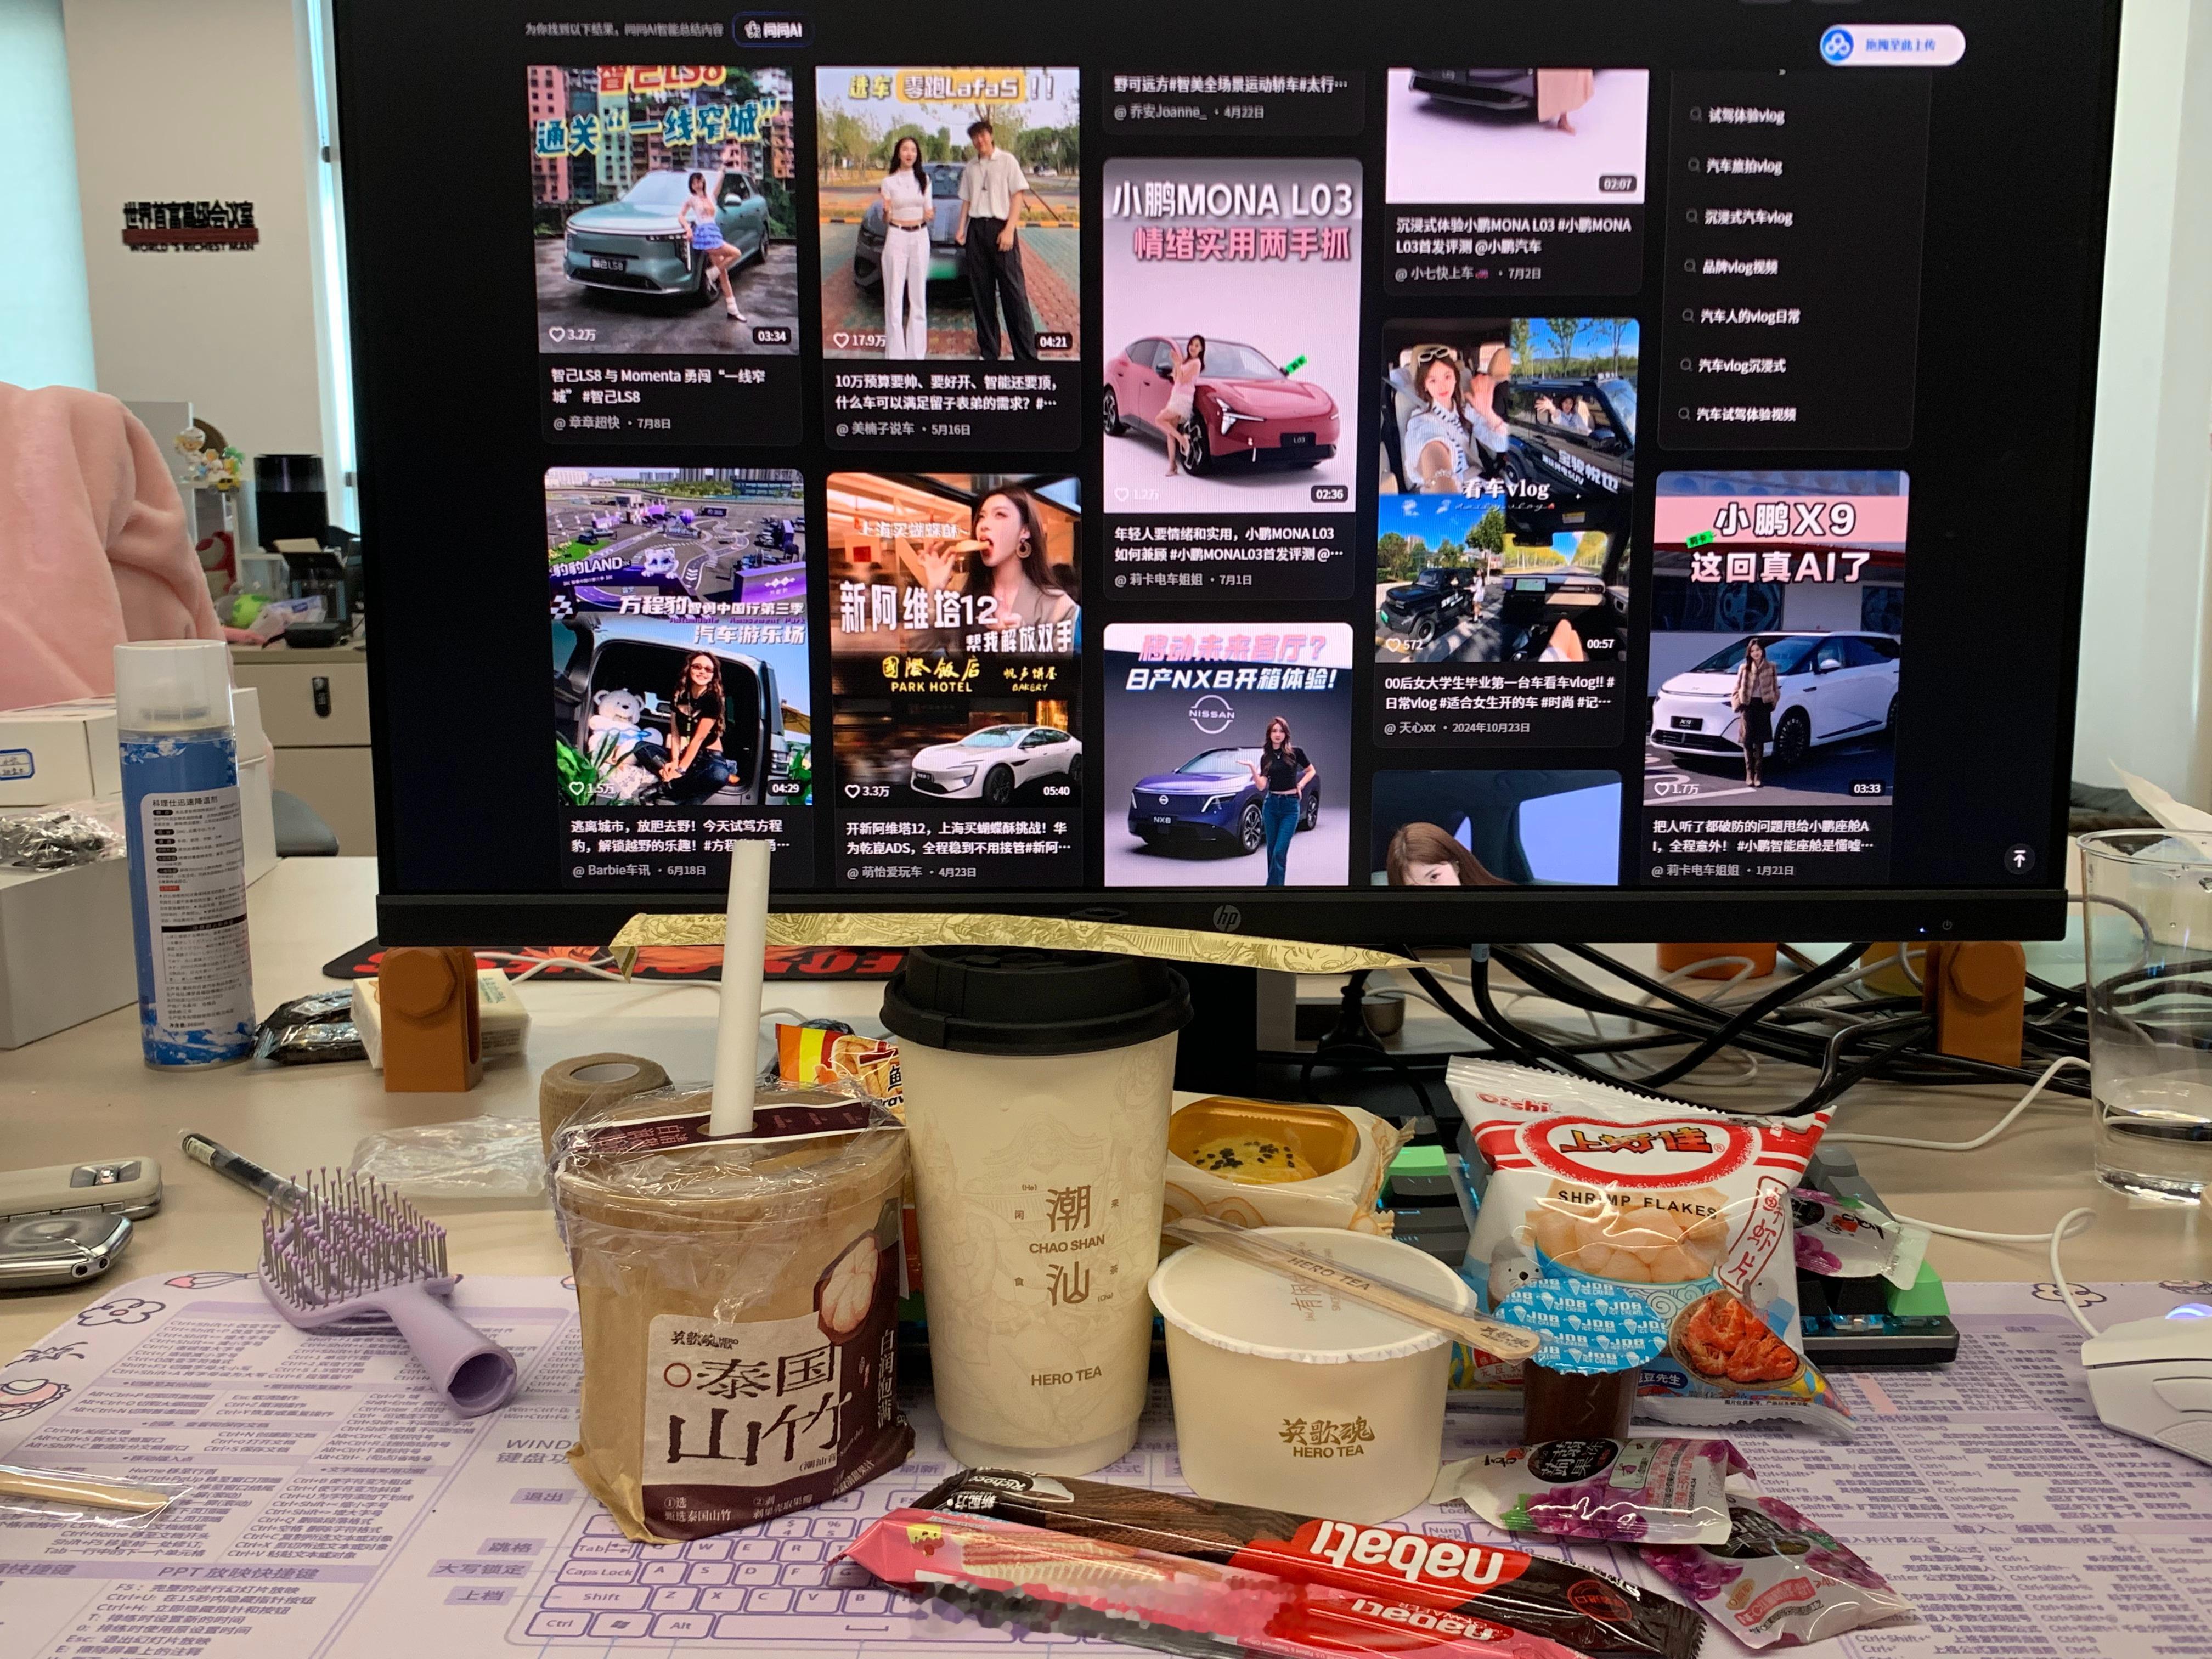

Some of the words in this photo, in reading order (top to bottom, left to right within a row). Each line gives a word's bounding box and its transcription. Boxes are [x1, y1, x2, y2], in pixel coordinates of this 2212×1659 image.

[763, 22, 802, 38] 问问AI
[1224, 106, 1264, 119] 4月22日
[1706, 158, 1782, 176] 汽车旅拍vlog
[1604, 179, 1632, 190] 02:07
[1112, 180, 1280, 217] 小鹏MONA
[1292, 183, 1353, 217] L03
[1396, 217, 1530, 233] 沉浸式体验小鹏MONA
[1532, 218, 1555, 232] L03
[1558, 217, 1632, 233] #小鹏MONA
[1705, 210, 1793, 227] 沉浸式汽车vlog
[1133, 226, 1350, 261] 情绪实用两手抓
[1396, 238, 1472, 255] L03首发评测
[1475, 238, 1542, 256] @小鹏汽车
[1410, 266, 1474, 280] 小七快上车
[1508, 268, 1541, 280] 7月2日
[1702, 258, 1778, 276] 品牌vlog视频
[1701, 308, 1801, 325] 汽车人的vlog日常
[568, 329, 596, 341] 3.2万
[758, 331, 786, 342] 03:34
[852, 334, 886, 347] 17.9万
[1040, 336, 1067, 348] 04:21
[1699, 358, 1786, 375] 汽车vlog沉浸式
[551, 369, 602, 383] 智己LS8
[605, 369, 617, 383] 与
[621, 369, 681, 382] Momenta
[583, 390, 640, 404] #智己LS8
[1697, 407, 1796, 422] 汽车试驾体验视频
[569, 416, 620, 430] 章章超快
[637, 418, 671, 430] 7月8日
[932, 424, 970, 436] 5月16日
[1316, 489, 1344, 500] 02:36
[1463, 478, 1550, 500] 看车vlog
[1713, 501, 1857, 538] 小鹏X9
[1312, 528, 1334, 540] L03
[1115, 548, 1167, 562] 如何兼顾
[1690, 551, 1871, 584] 这回真AI了
[1130, 572, 1203, 586] 莉卡电车姐姐
[1220, 575, 1252, 586] 7月1日
[840, 580, 998, 634] 新阿维塔12
[694, 625, 805, 645] 汽车游乐场
[966, 619, 1073, 653] 帮我解放双手
[1403, 640, 1423, 651] 572
[1587, 639, 1614, 649] 00:57
[891, 681, 925, 692] PARK
[929, 681, 972, 692] HOTEL
[1012, 684, 1048, 692] BAKERY
[1386, 696, 1437, 711] 日常vlog
[1440, 696, 1538, 710] #适合女生开的车
[1541, 696, 1574, 709] #时尚
[1189, 709, 1235, 719] NISSAN
[1453, 723, 1530, 733] 2024年10月23日
[772, 783, 799, 793] 04:29
[862, 786, 890, 797] 3.3万
[1043, 786, 1070, 796] 05:40
[1672, 783, 1699, 794] 1.7万
[1854, 783, 1881, 794] 03:33
[588, 864, 651, 876] Barbie车讯
[667, 865, 706, 876] 6月18日
[862, 866, 922, 878] 萌怡爱玩车
[939, 867, 977, 878] 4月23日
[1667, 864, 1739, 877] 莉卡电车姐姐
[1756, 866, 1794, 877] 1月21日
[1214, 904, 1241, 933] hp
[1476, 1092, 1553, 1113] Oishi
[1559, 1127, 1714, 1154] 上好佳
[1046, 1184, 1091, 1233] 潮
[1558, 1190, 1631, 1207] SHRIMP
[1643, 1197, 1718, 1220] FLAKES
[1029, 1242, 1068, 1254] CHAO
[1070, 1234, 1105, 1251] SHAN
[1288, 1257, 1335, 1276] HERO
[1340, 1276, 1370, 1290] TEA
[1046, 1261, 1090, 1307] 汕
[1581, 1282, 1614, 1290] JDB
[1554, 1297, 1587, 1308] JDB
[718, 1337, 739, 1345] HERO
[696, 1345, 837, 1400] 泰国
[1031, 1372, 1073, 1386] HERO
[1076, 1365, 1102, 1381] TEA
[667, 1391, 852, 1466] 山竹
[1278, 1415, 1375, 1445] 英歌魂
[1293, 1446, 1335, 1458] HERO
[1337, 1444, 1364, 1457] TEA
[522, 1491, 565, 1503] 退出
[955, 1494, 997, 1509] 新配方
[488, 1541, 534, 1553] 跳格
[578, 1544, 605, 1554] Tab
[1309, 1520, 1504, 1585] nabati
[157, 1566, 204, 1577] PPT
[204, 1566, 320, 1580] 放映快捷键
[434, 1562, 527, 1576] 大写锁定
[565, 1567, 599, 1578] Caps
[601, 1567, 633, 1577] Lock
[456, 1589, 505, 1602] 上档
[582, 1592, 620, 1602] Shift
[546, 1619, 573, 1628] Ctrl
[669, 1621, 692, 1630] Alt
